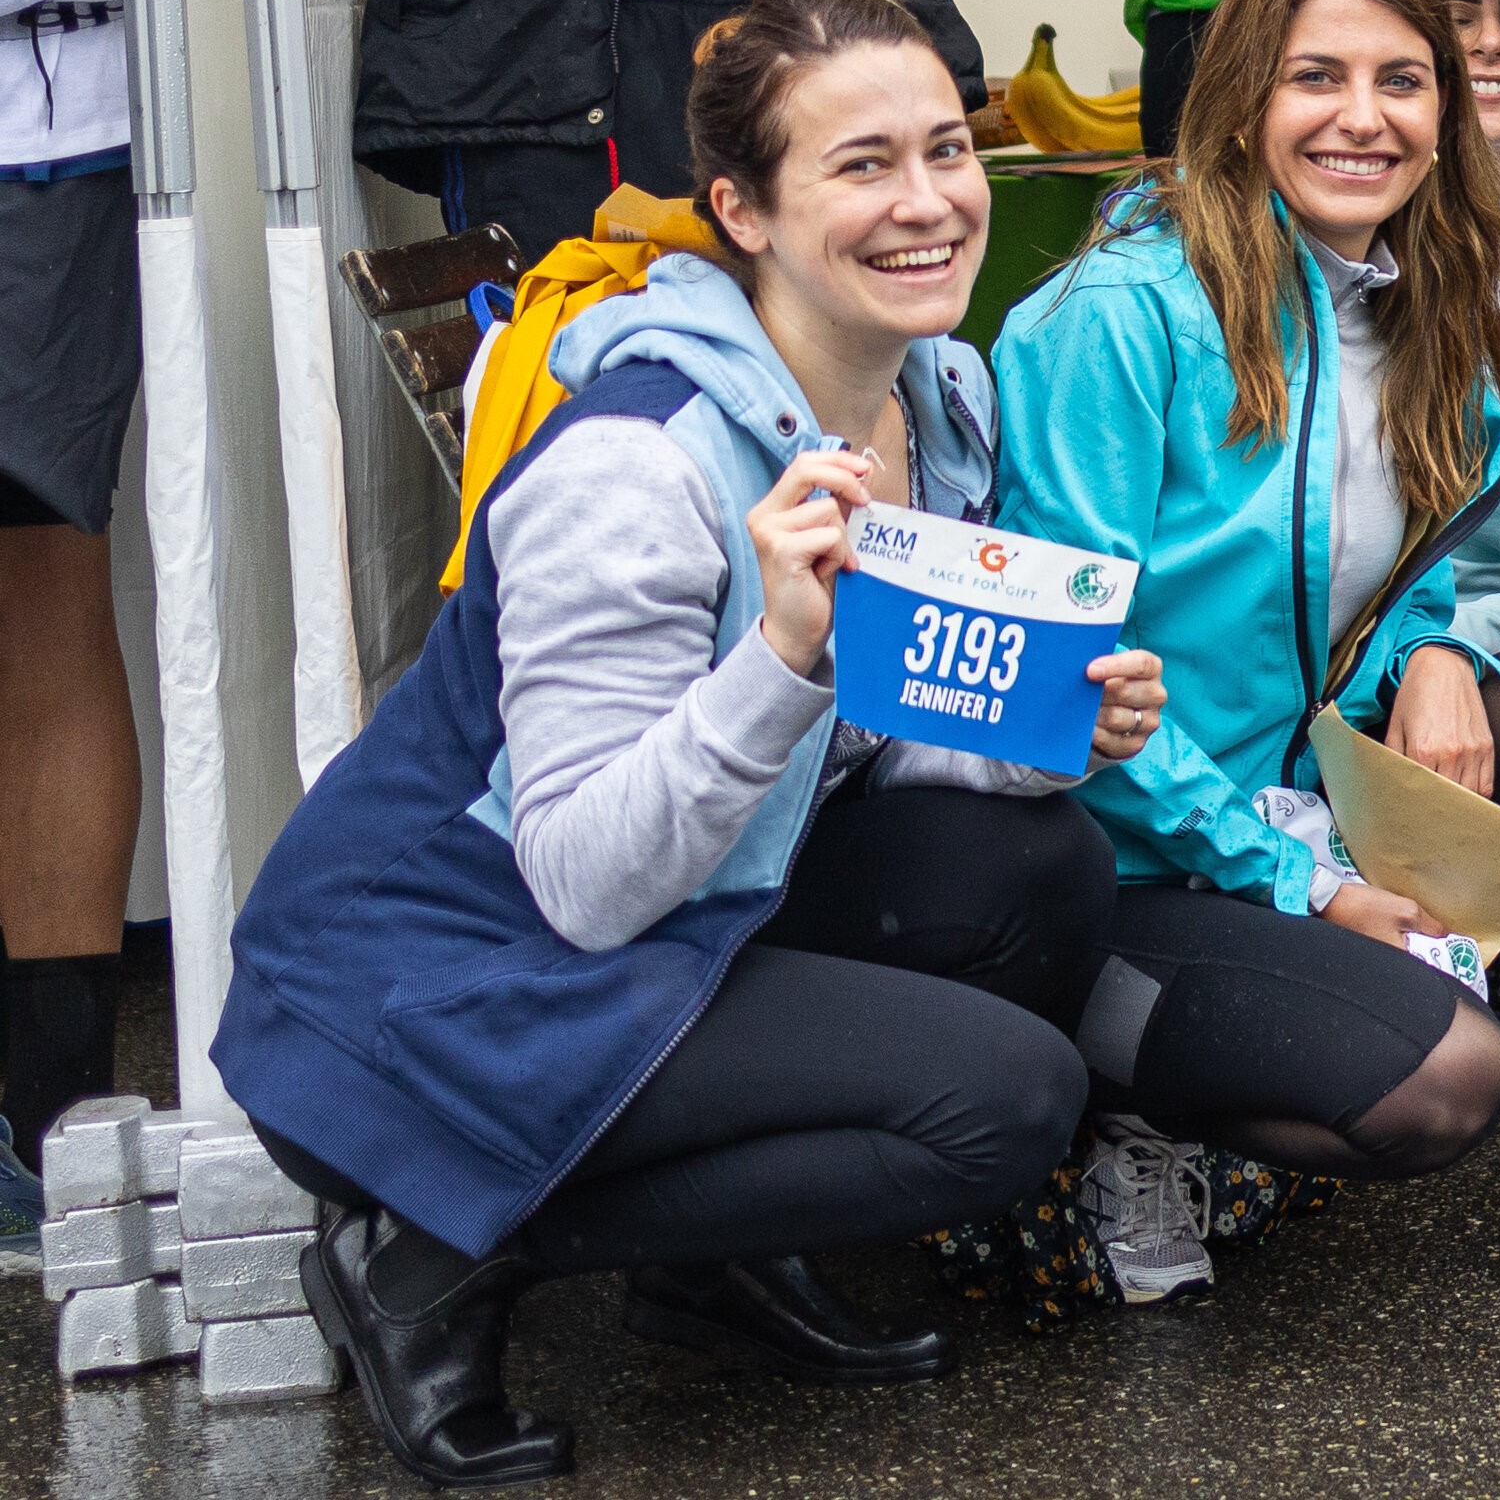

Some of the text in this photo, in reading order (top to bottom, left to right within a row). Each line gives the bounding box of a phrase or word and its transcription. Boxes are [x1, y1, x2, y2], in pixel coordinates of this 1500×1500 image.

[856, 542, 913, 565] MARCHE
[860, 521, 918, 552] 5KM
[928, 567, 1038, 602] RACE FOR GIFT
[903, 603, 1026, 692] 3193
[899, 678, 986, 722] JENNIFER
